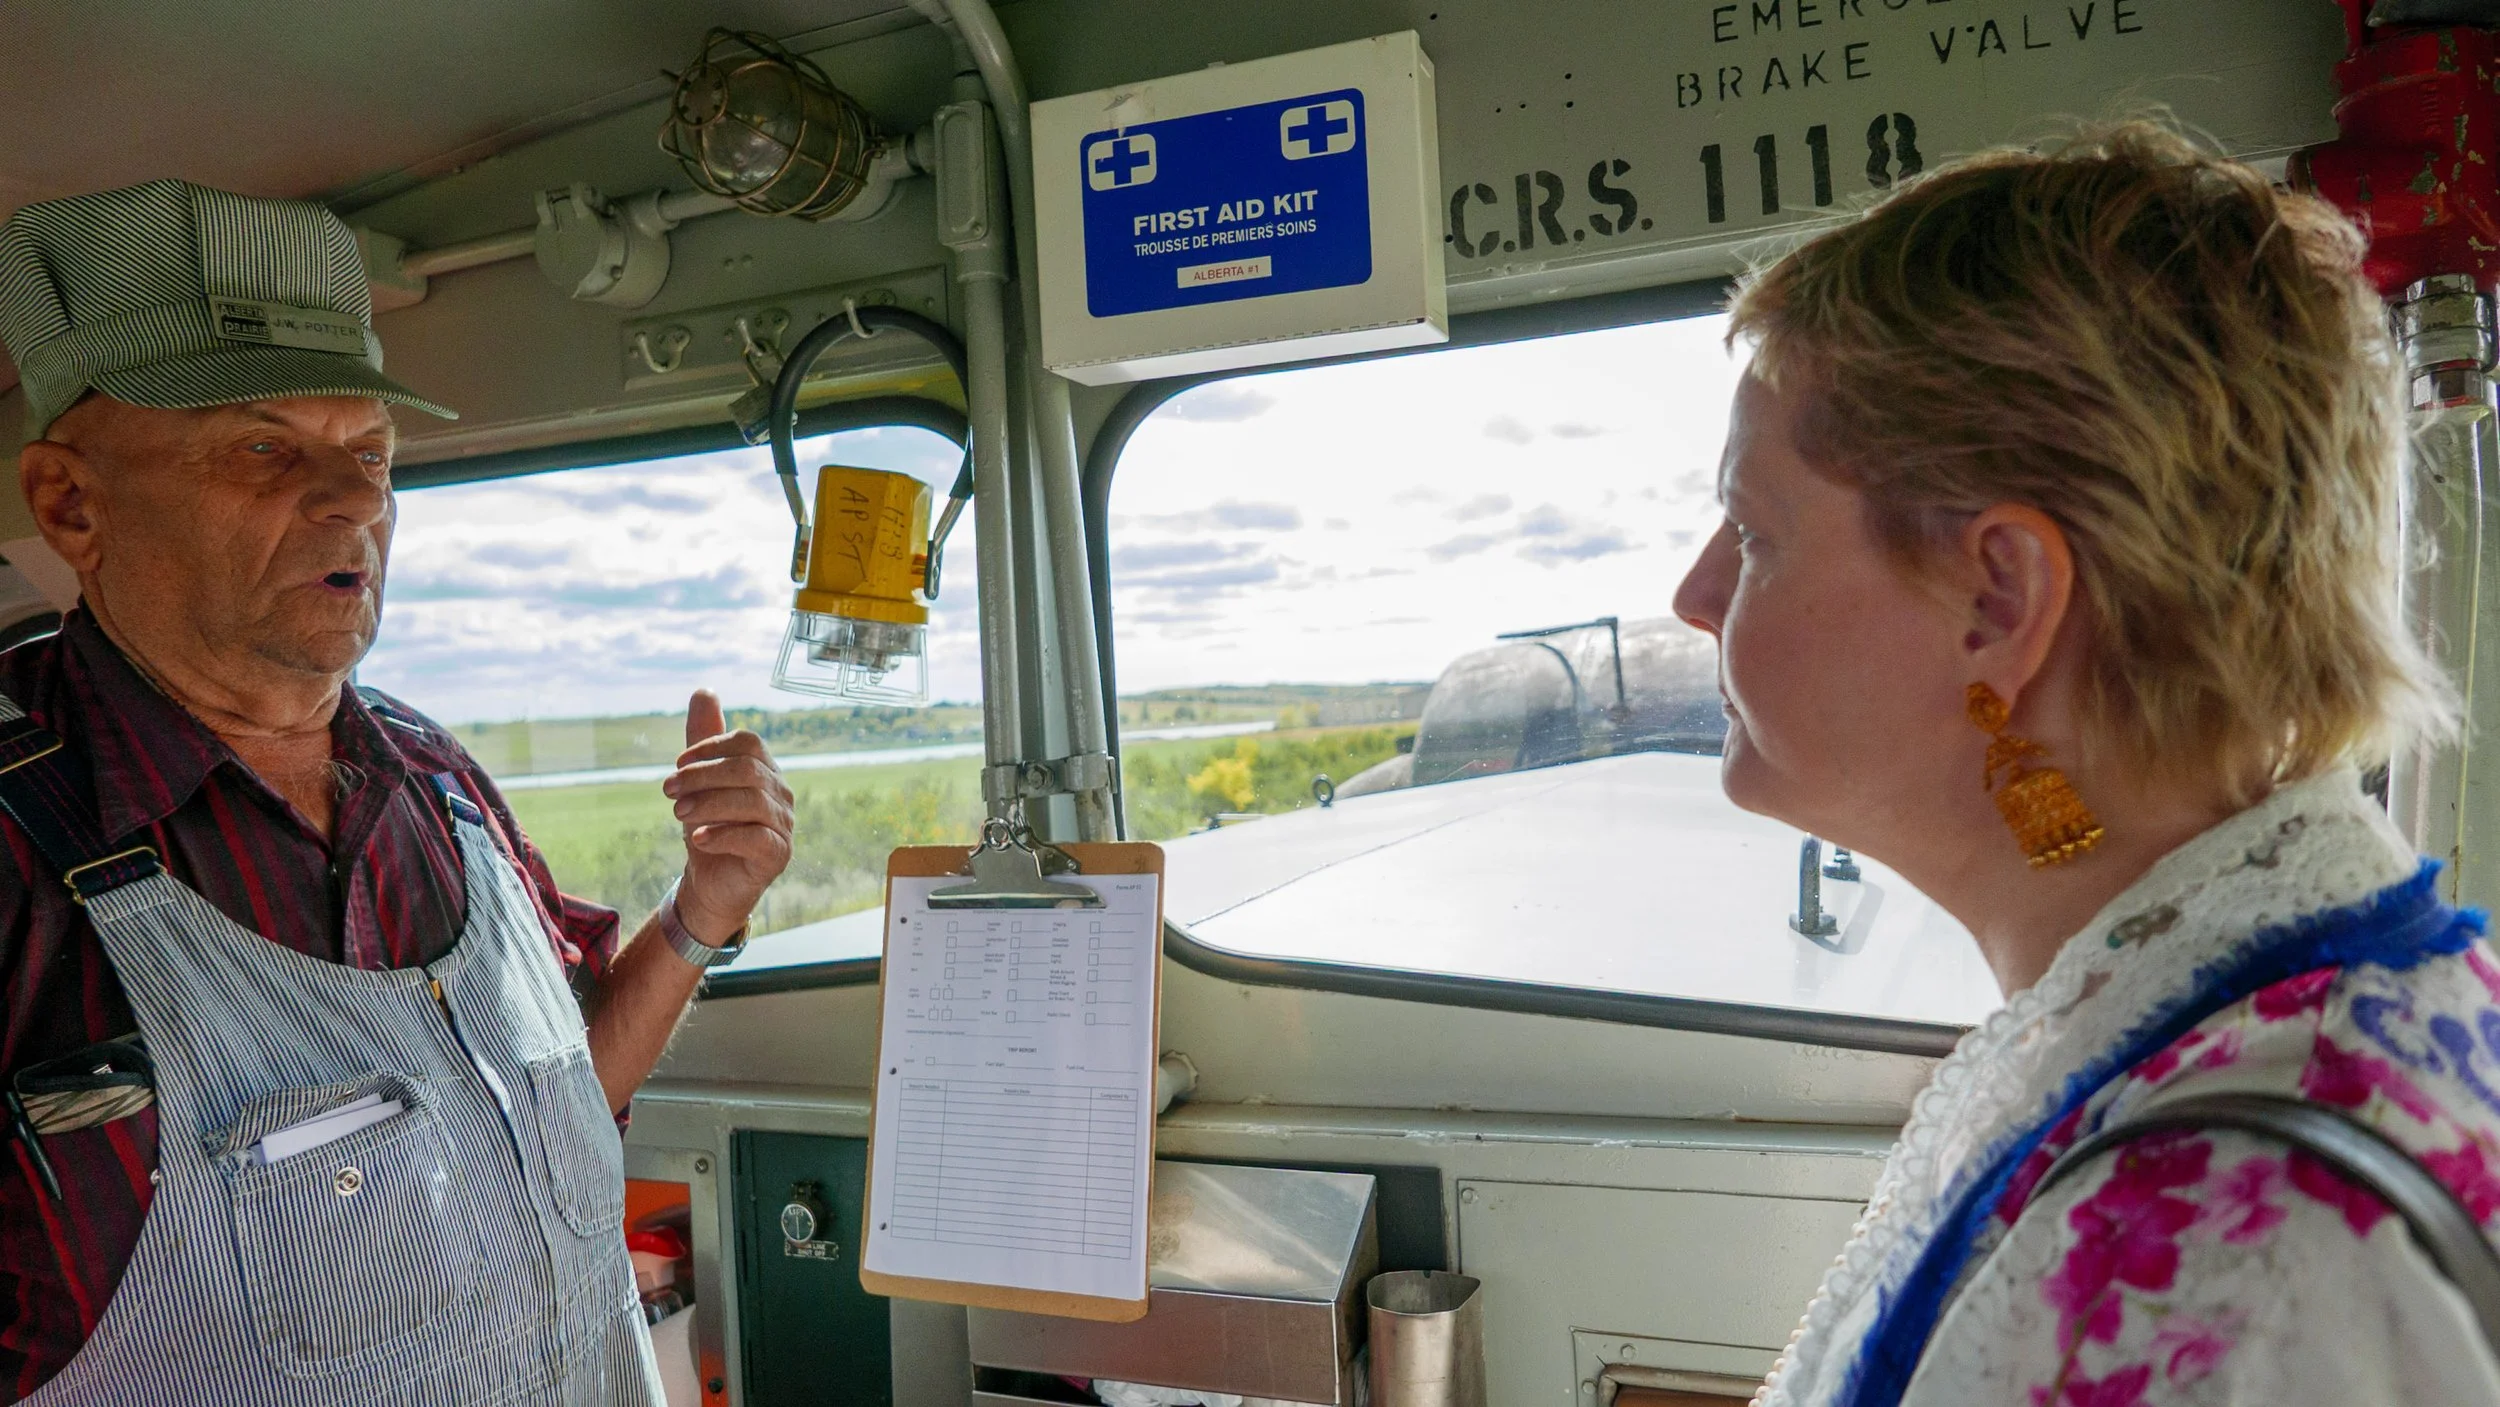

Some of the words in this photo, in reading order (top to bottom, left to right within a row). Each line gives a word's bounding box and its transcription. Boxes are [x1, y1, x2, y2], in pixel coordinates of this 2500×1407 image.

[1676, 42, 1871, 108] BRAKE
[1929, 0, 2143, 65] VALVE
[1449, 158, 1654, 259] C.R.S.
[1699, 112, 1924, 224] 1118
[1133, 206, 1209, 237] FIRST
[1217, 199, 1265, 224] AID
[1273, 190, 1319, 216] KIT
[1134, 234, 1190, 257] TROUSSE
[1192, 234, 1209, 249] DE
[1211, 224, 1274, 246] PREMIERS
[1276, 219, 1317, 237] SOINS
[1193, 264, 1244, 281] ALBERTA
[1247, 264, 1260, 276] #1
[224, 321, 270, 339] PRAIRIE
[305, 321, 357, 337] POTTER
